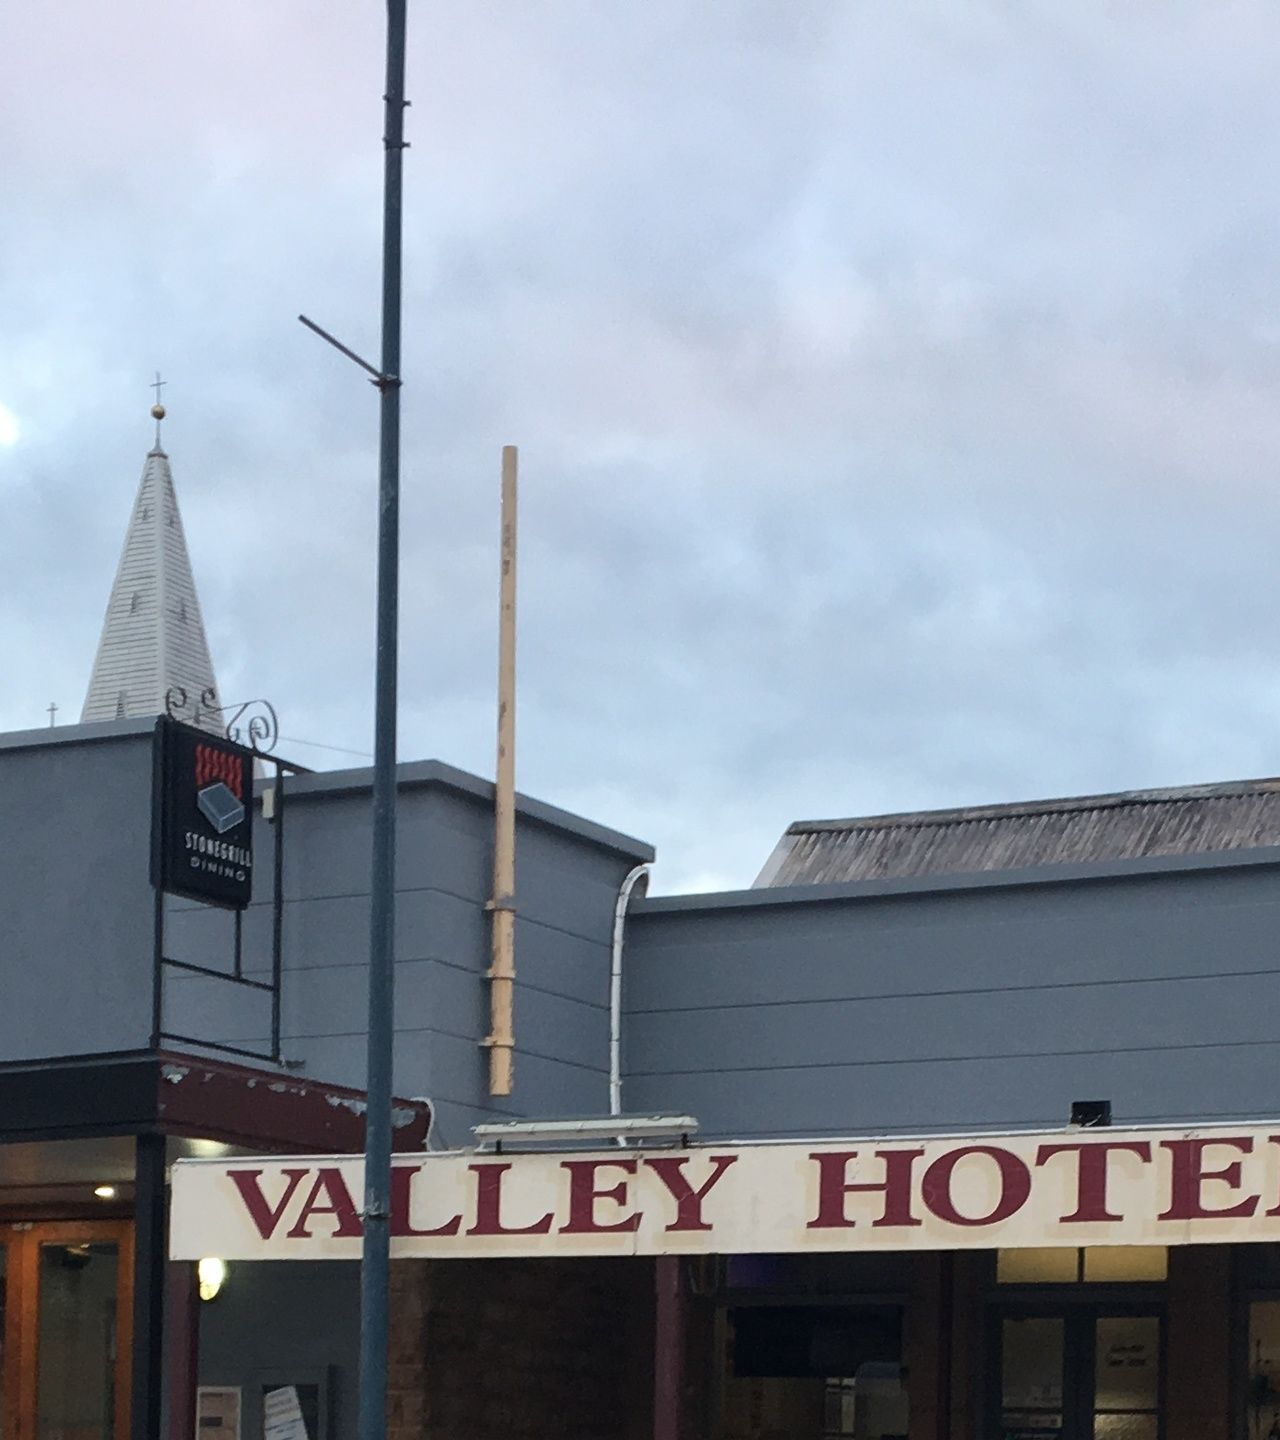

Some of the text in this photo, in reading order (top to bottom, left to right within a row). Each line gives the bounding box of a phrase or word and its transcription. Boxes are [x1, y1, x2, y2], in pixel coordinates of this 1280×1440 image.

[185, 832, 252, 868] STONEGRILL
[190, 856, 246, 882] DINING
[227, 1155, 738, 1240] VALLEY
